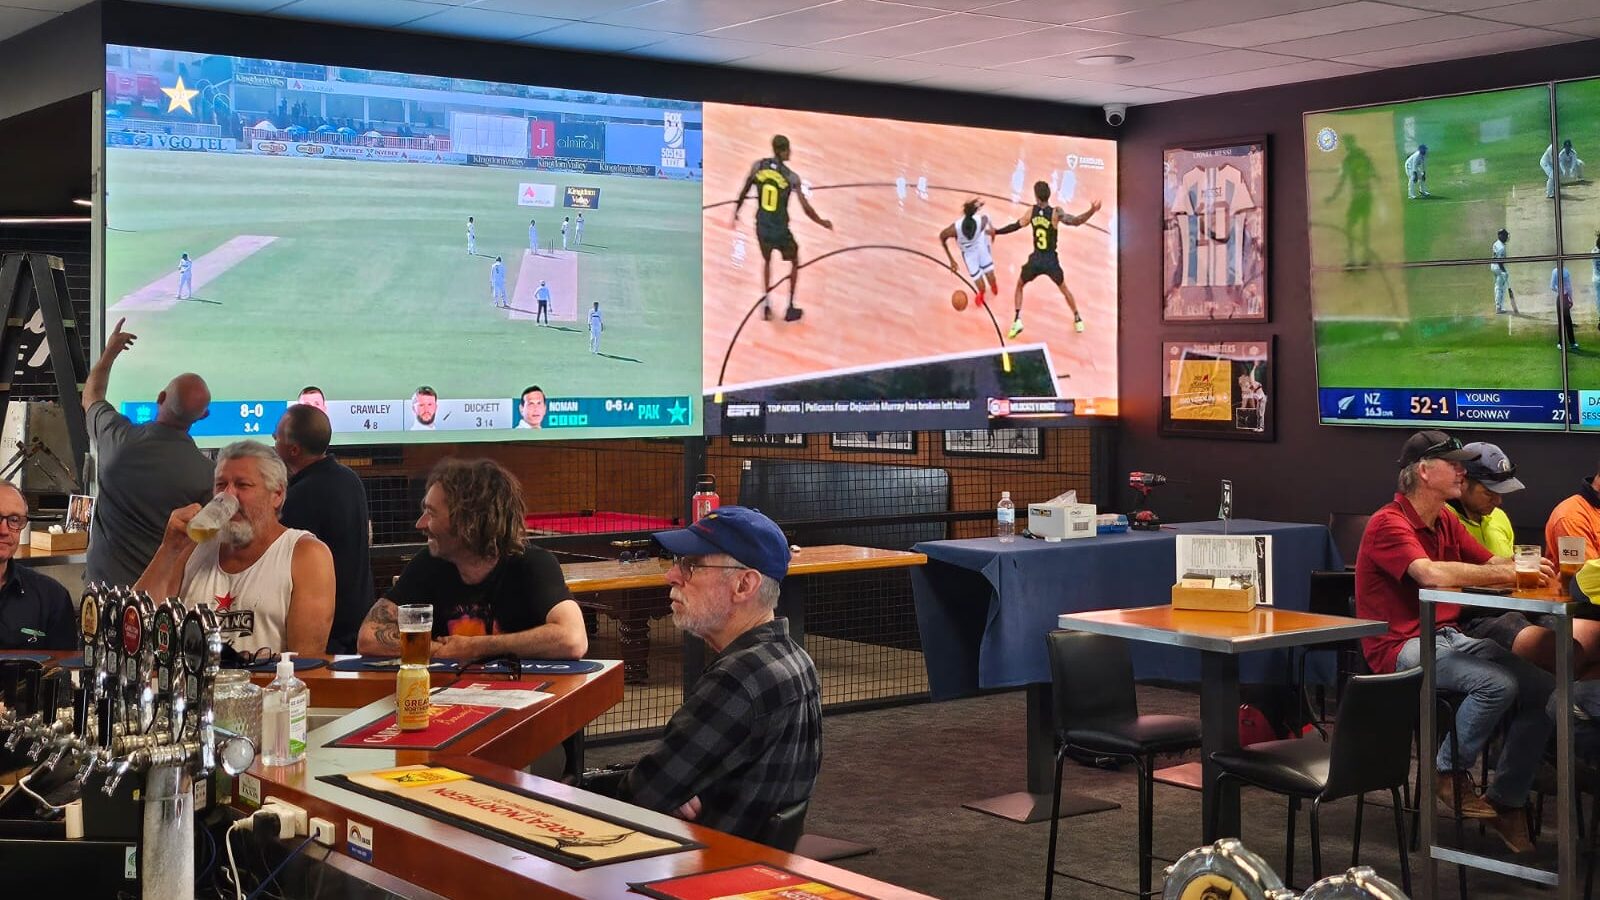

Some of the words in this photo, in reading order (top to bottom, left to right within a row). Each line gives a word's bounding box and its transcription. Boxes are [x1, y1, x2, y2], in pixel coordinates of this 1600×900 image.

[196, 137, 228, 151] TEL
[761, 183, 779, 212] 0
[1035, 228, 1048, 250] 3
[1364, 393, 1381, 405] NZ
[1465, 393, 1501, 403] YOUNG
[240, 403, 264, 418] 8-0
[350, 404, 391, 415] CRAWLEY
[464, 403, 500, 413] DUCKETT
[549, 401, 579, 412] NOMAN
[727, 404, 760, 417] ESPN
[768, 404, 781, 412] TOP
[782, 404, 800, 412] NEWS
[805, 402, 834, 412] Pelicans
[881, 401, 904, 412] Murray
[905, 401, 917, 410] has
[1411, 396, 1449, 414] 52-1
[638, 404, 660, 420] PAK
[1466, 409, 1510, 420] CONWAY
[244, 422, 259, 432] 3.4
[363, 419, 371, 430] 4
[475, 417, 482, 427] 3
